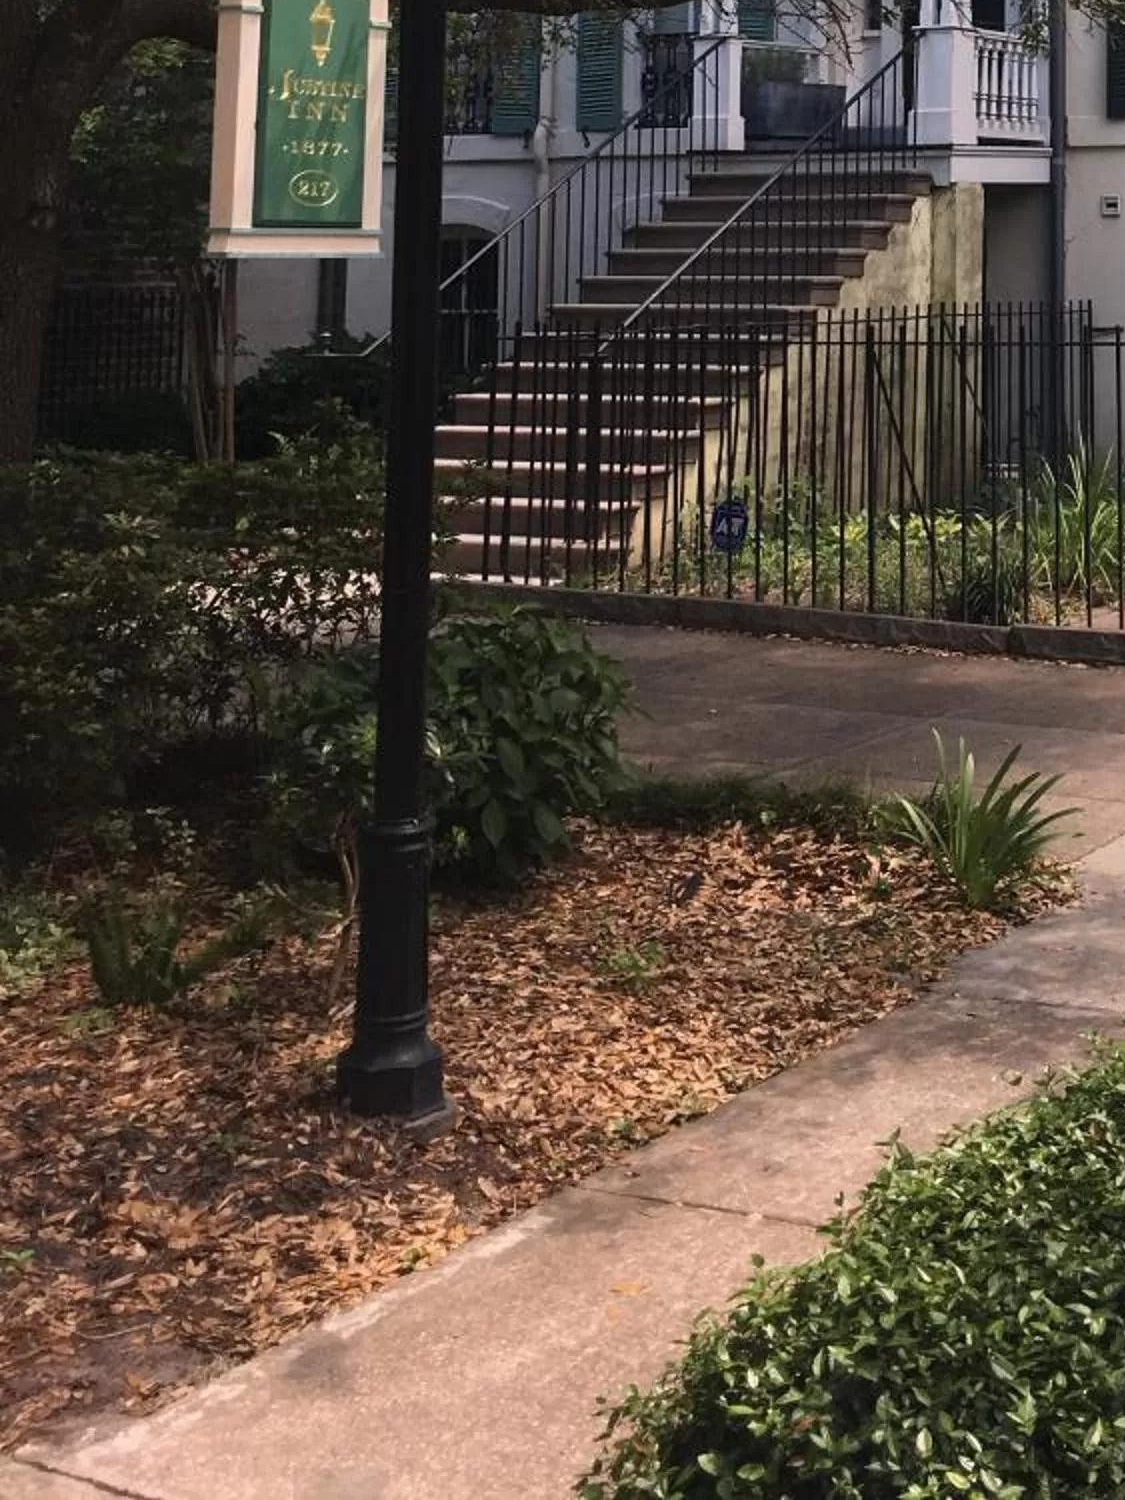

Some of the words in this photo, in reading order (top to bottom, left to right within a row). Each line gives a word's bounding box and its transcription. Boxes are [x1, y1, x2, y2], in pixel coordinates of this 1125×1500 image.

[287, 100, 348, 123] INN
[291, 140, 343, 156] 1877
[297, 180, 332, 197] 217
